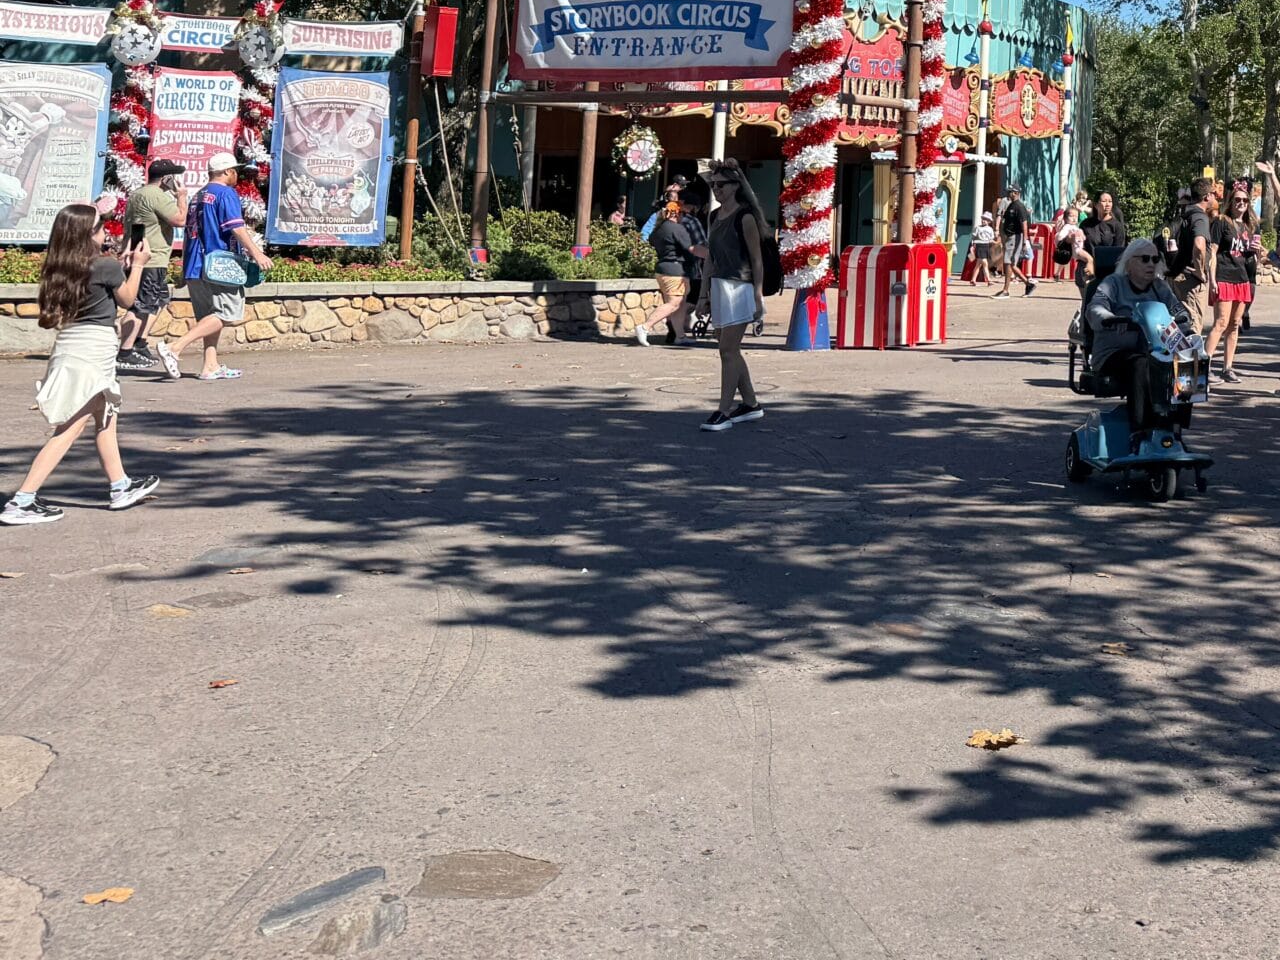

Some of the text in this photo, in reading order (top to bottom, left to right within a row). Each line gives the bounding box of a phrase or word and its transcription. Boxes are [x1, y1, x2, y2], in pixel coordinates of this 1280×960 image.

[175, 20, 231, 33] STORYBOOK
[551, 3, 751, 32] STORYBOOK CIRCUS
[292, 25, 392, 50] SURPRISING
[17, 72, 36, 81] SILLY
[36, 71, 100, 92] SIDESHOW
[164, 78, 233, 90] A WORLD OF
[303, 81, 370, 99] DUMBO
[157, 92, 236, 112] CIRCUS FUN
[153, 130, 234, 149] ASTONISHING
[180, 145, 204, 155] ACTS
